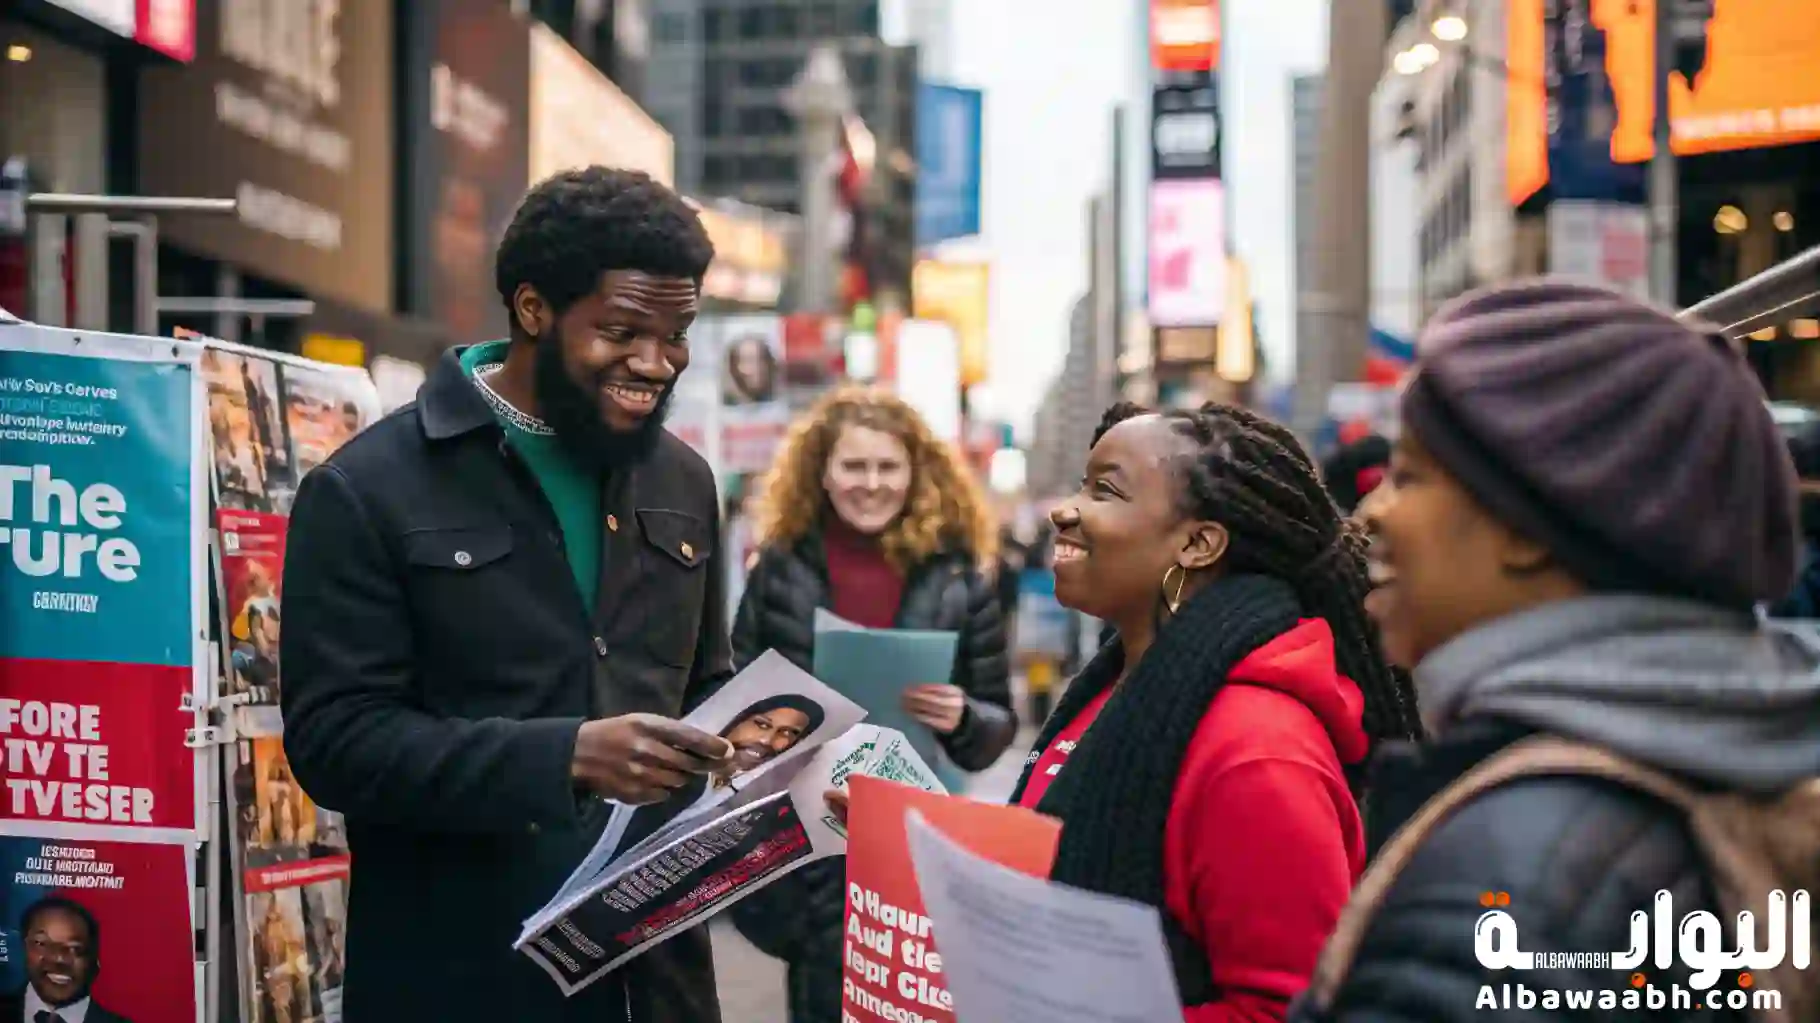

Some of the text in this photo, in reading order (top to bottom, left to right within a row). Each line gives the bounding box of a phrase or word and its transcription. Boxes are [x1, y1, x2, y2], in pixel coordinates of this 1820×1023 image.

[0, 464, 126, 530] The
[0, 698, 100, 741] FORE
[64, 743, 109, 781] TE
[6, 779, 154, 823] TVESER
